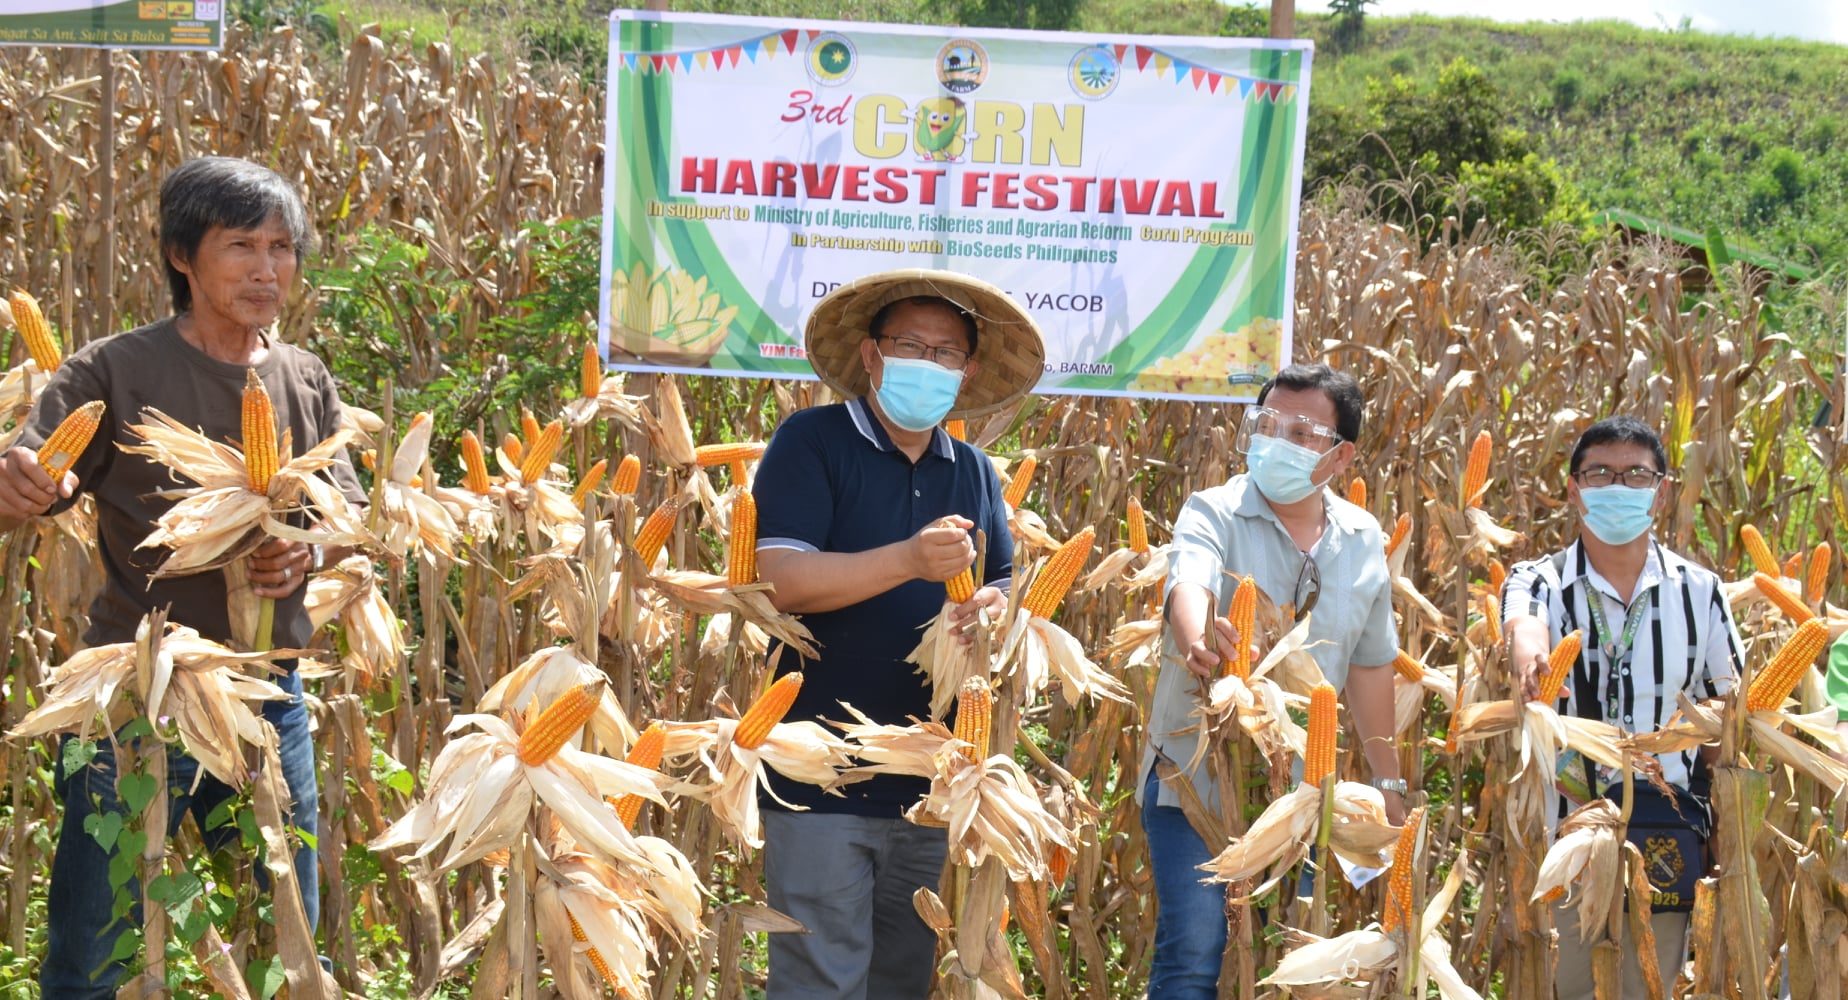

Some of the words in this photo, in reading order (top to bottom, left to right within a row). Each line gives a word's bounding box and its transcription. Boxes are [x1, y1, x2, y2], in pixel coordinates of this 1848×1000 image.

[32, 28, 48, 40] Sa
[80, 29, 107, 42] Sulit
[112, 29, 128, 42] Sa
[131, 29, 165, 43] Bulsa
[780, 89, 853, 126] 3rd
[852, 94, 1085, 168] CORN
[680, 156, 947, 206] HARVEST
[961, 171, 1225, 219] FESTIVAL
[647, 200, 663, 217] In
[667, 202, 730, 221] support
[733, 204, 750, 221] to
[754, 205, 813, 228] Ministry
[815, 208, 831, 226] of
[832, 210, 915, 232] Agriculture,
[918, 214, 983, 234] Fisheries
[986, 217, 1012, 236] and
[1015, 218, 1078, 241] Agrarian
[1081, 220, 1133, 241] Reform
[1140, 225, 1179, 242] Corn
[1183, 226, 1254, 247] Program
[791, 231, 807, 248] In
[811, 233, 905, 253] Partnership
[908, 236, 943, 254] with
[947, 239, 1022, 259] BioSeeds
[1026, 243, 1118, 264] Philippines
[1025, 291, 1104, 313] YACOB
[1060, 362, 1113, 375] BARMM
